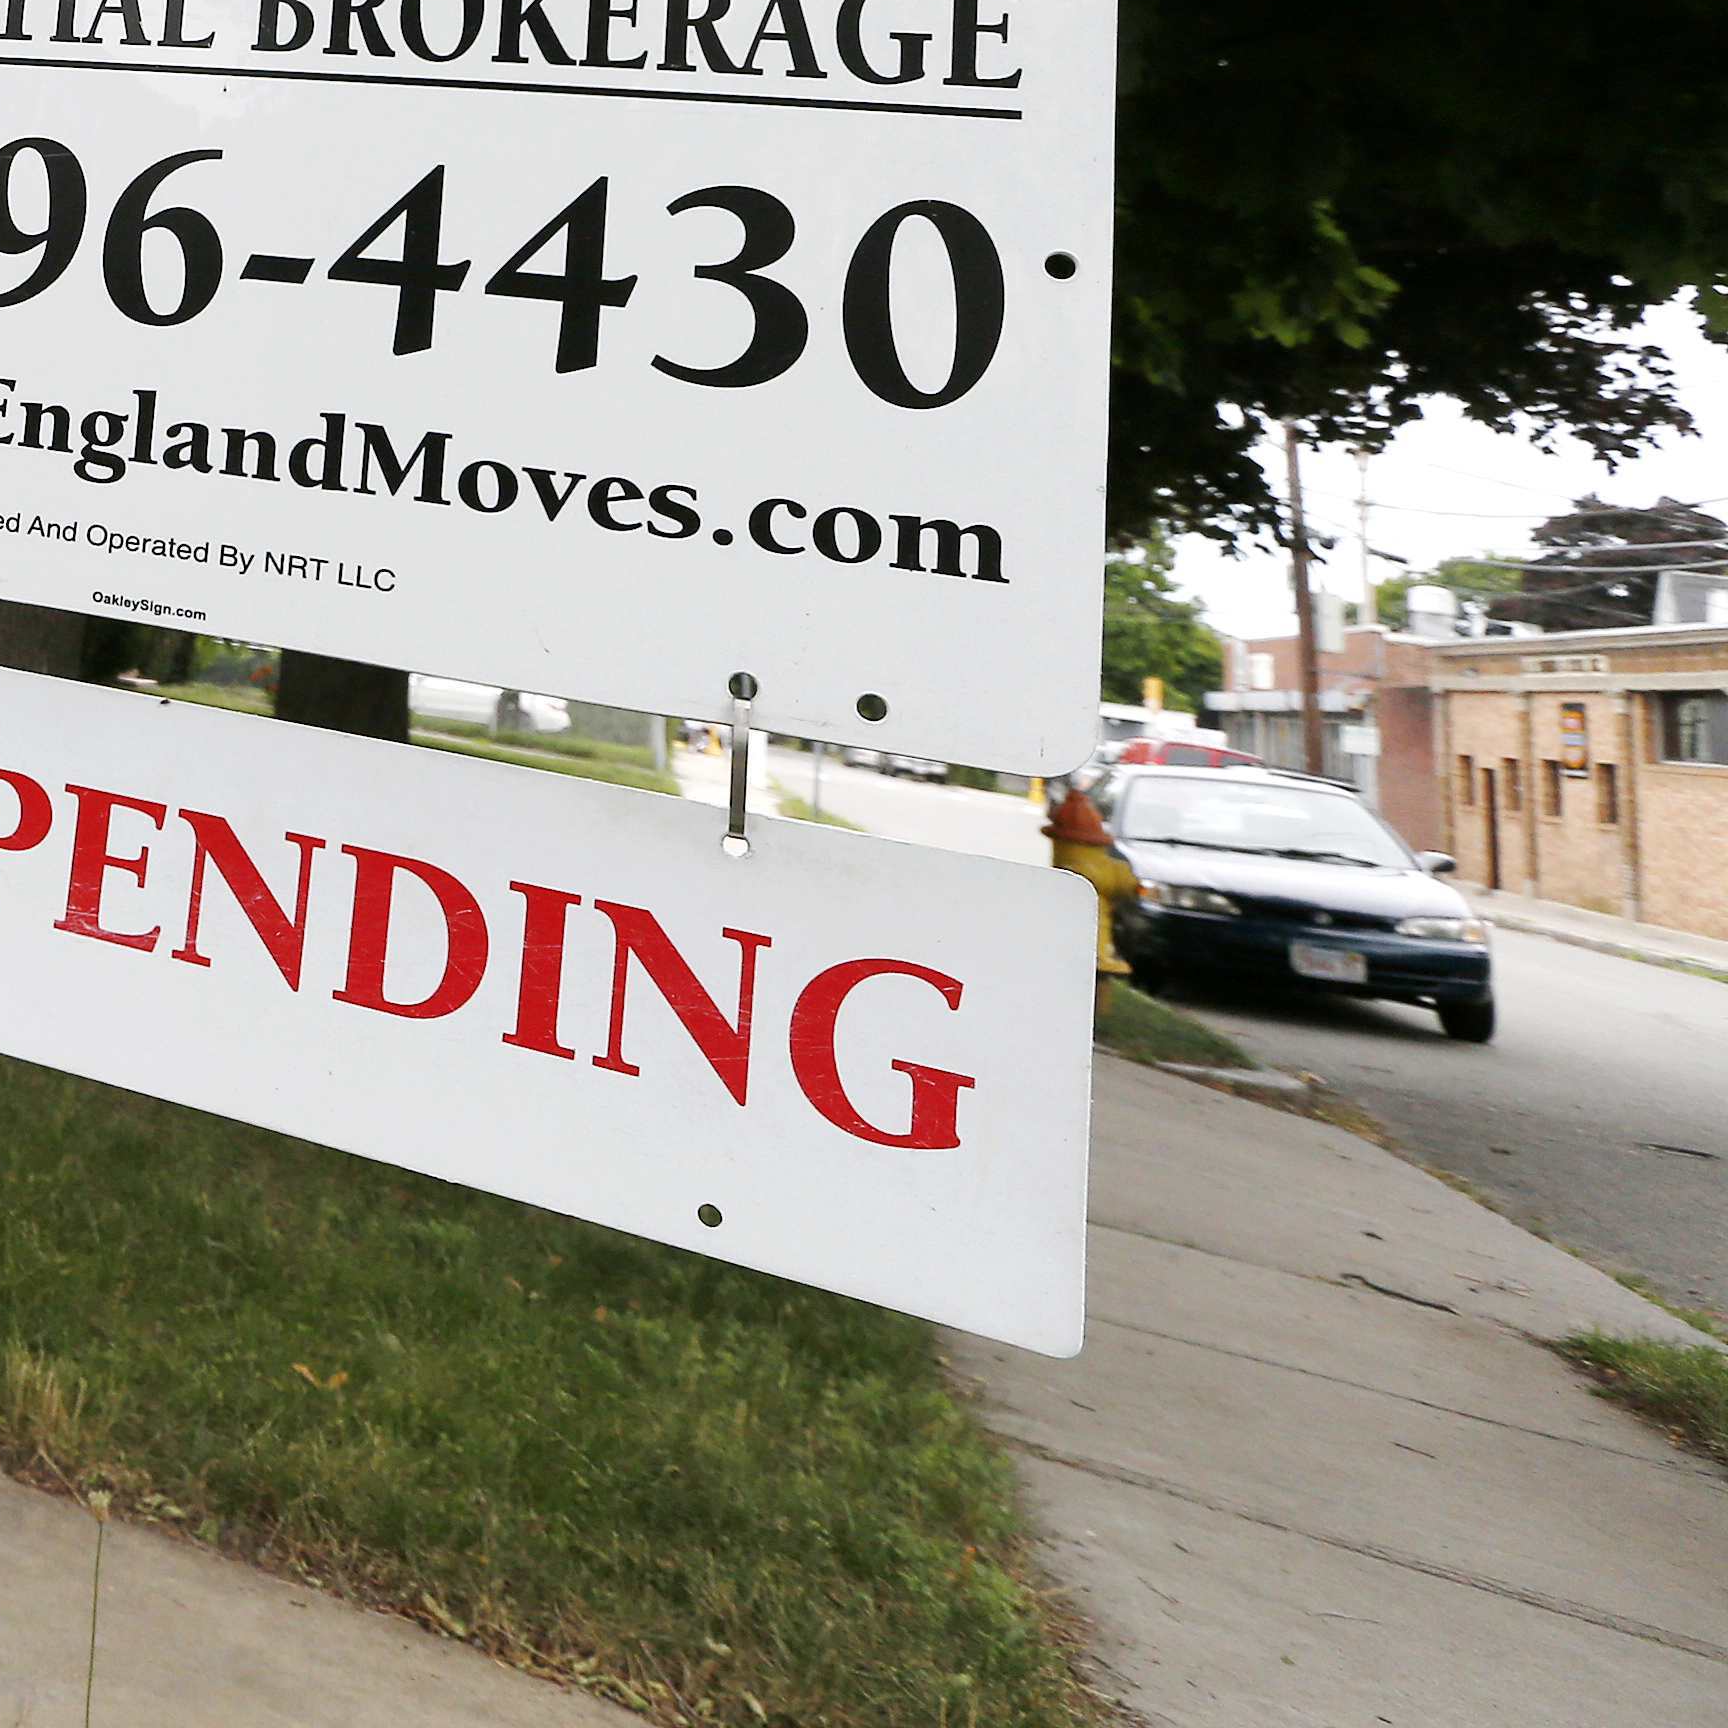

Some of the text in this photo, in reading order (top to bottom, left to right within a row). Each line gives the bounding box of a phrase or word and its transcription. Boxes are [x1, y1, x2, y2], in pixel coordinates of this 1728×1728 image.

[26, 515, 78, 543] And
[86, 524, 210, 564] Operated
[219, 544, 255, 575] By
[264, 551, 330, 582] NRT
[337, 562, 397, 593] LLC
[92, 590, 207, 622] OakleySign.com
